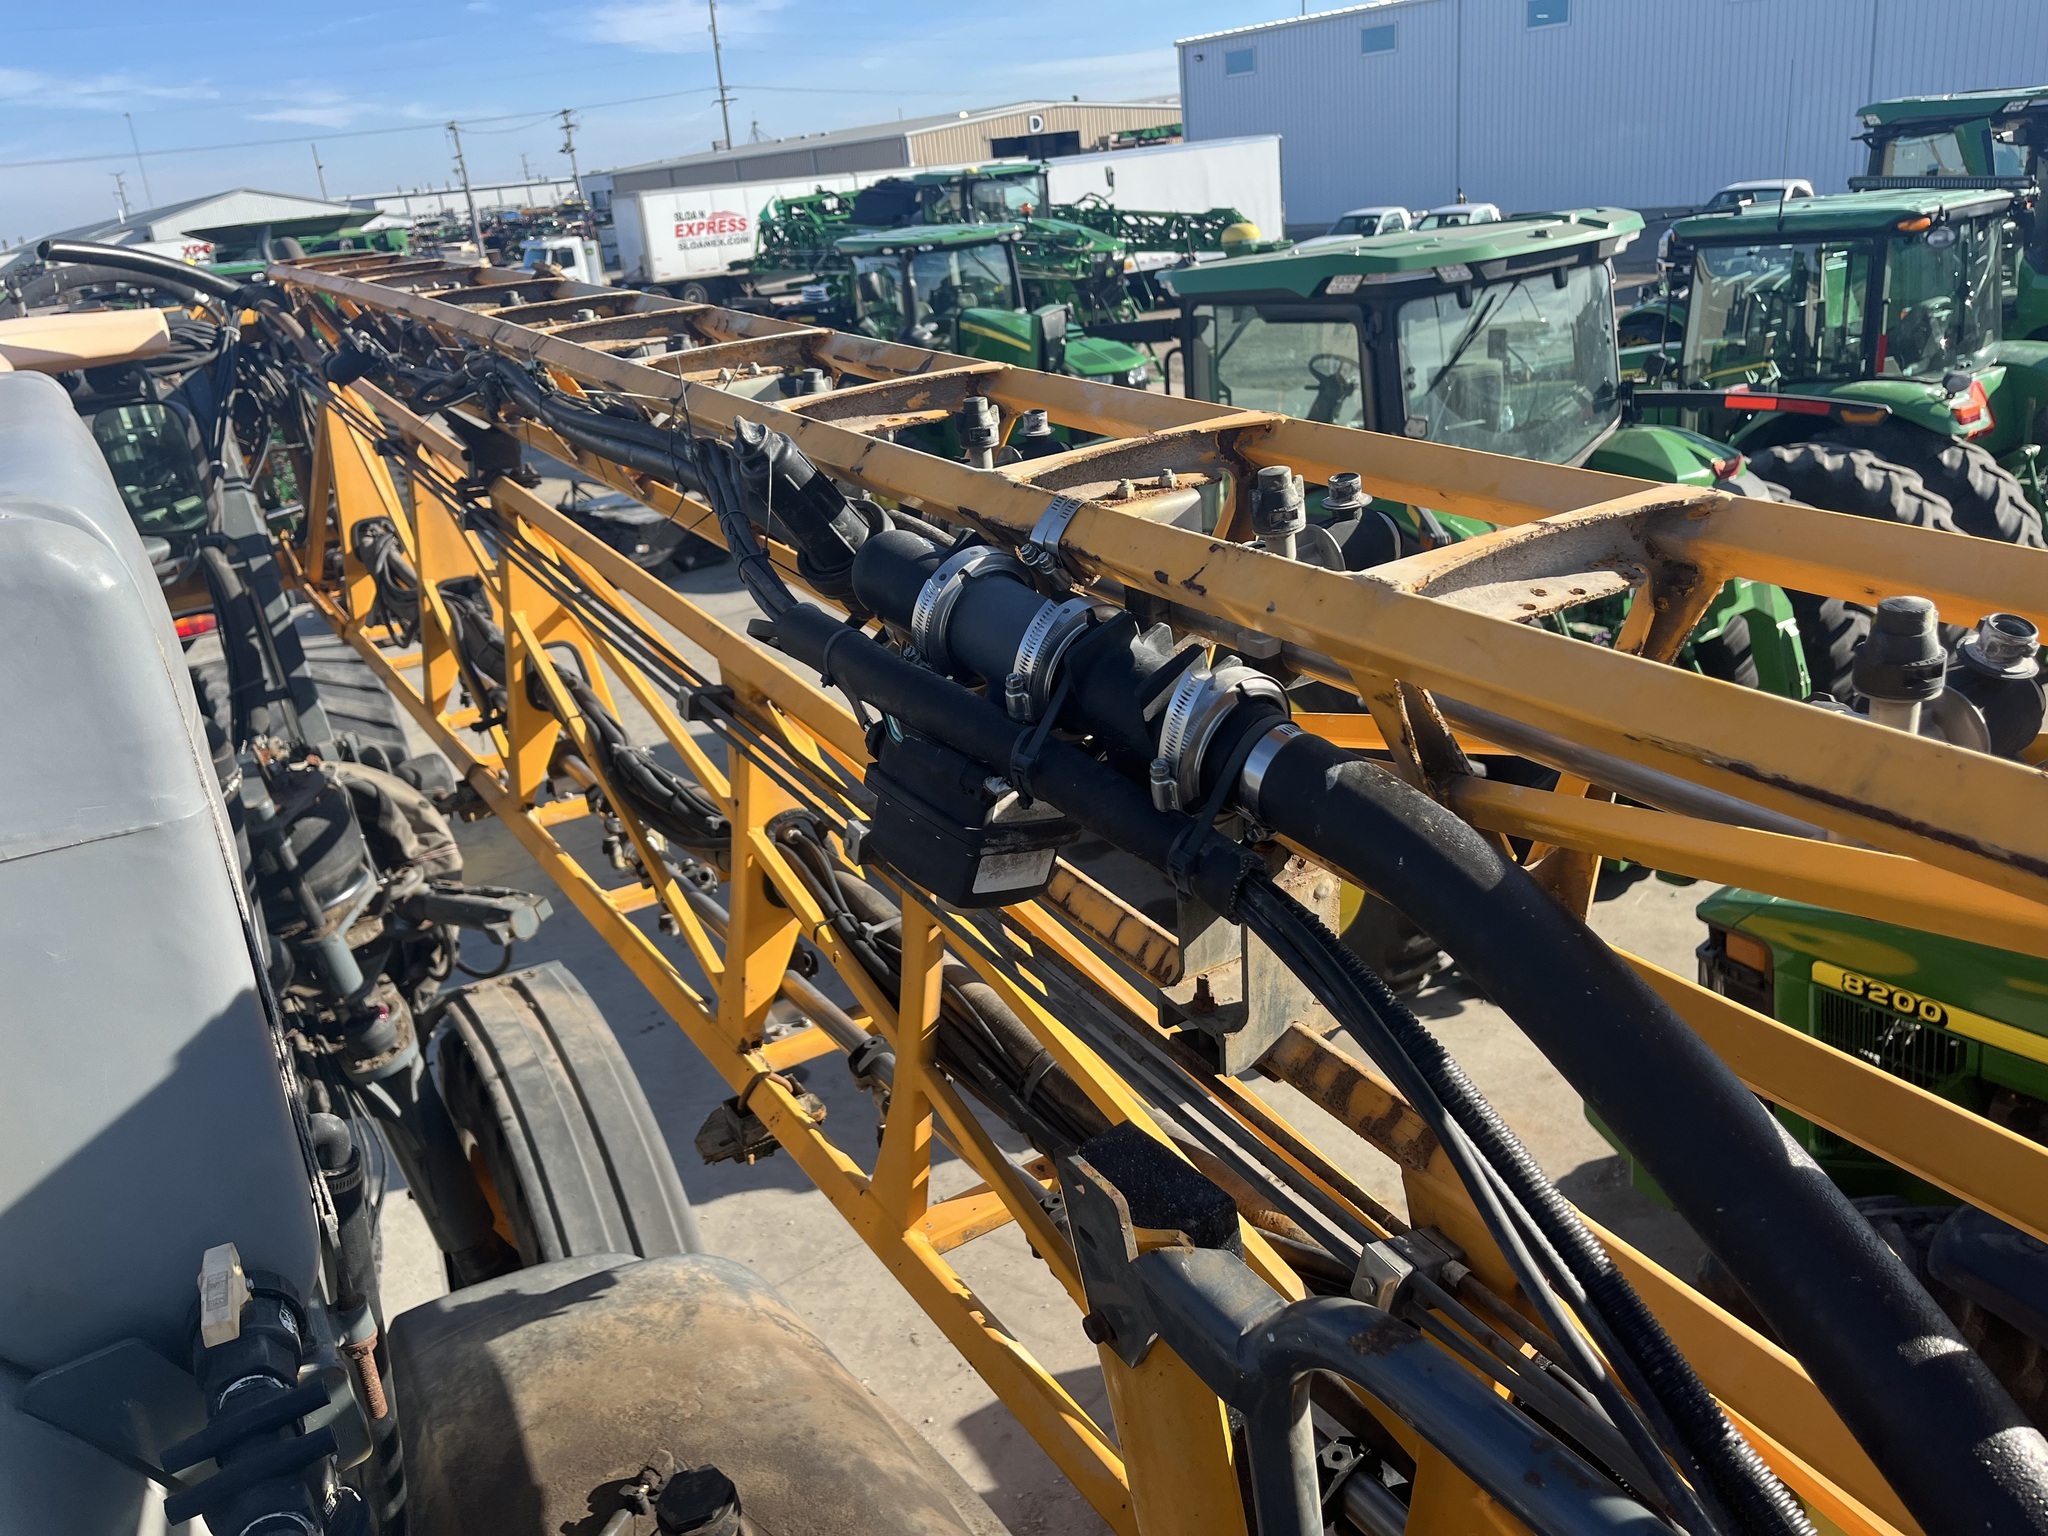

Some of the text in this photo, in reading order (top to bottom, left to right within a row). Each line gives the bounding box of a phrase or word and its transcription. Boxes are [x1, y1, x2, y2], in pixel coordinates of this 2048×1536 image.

[1029, 115, 1044, 133] D
[673, 209, 706, 221] SLOAN
[675, 218, 748, 238] EXPRESS
[678, 236, 749, 251] SLOANEX.COM
[1843, 974, 1942, 1024] 8200
